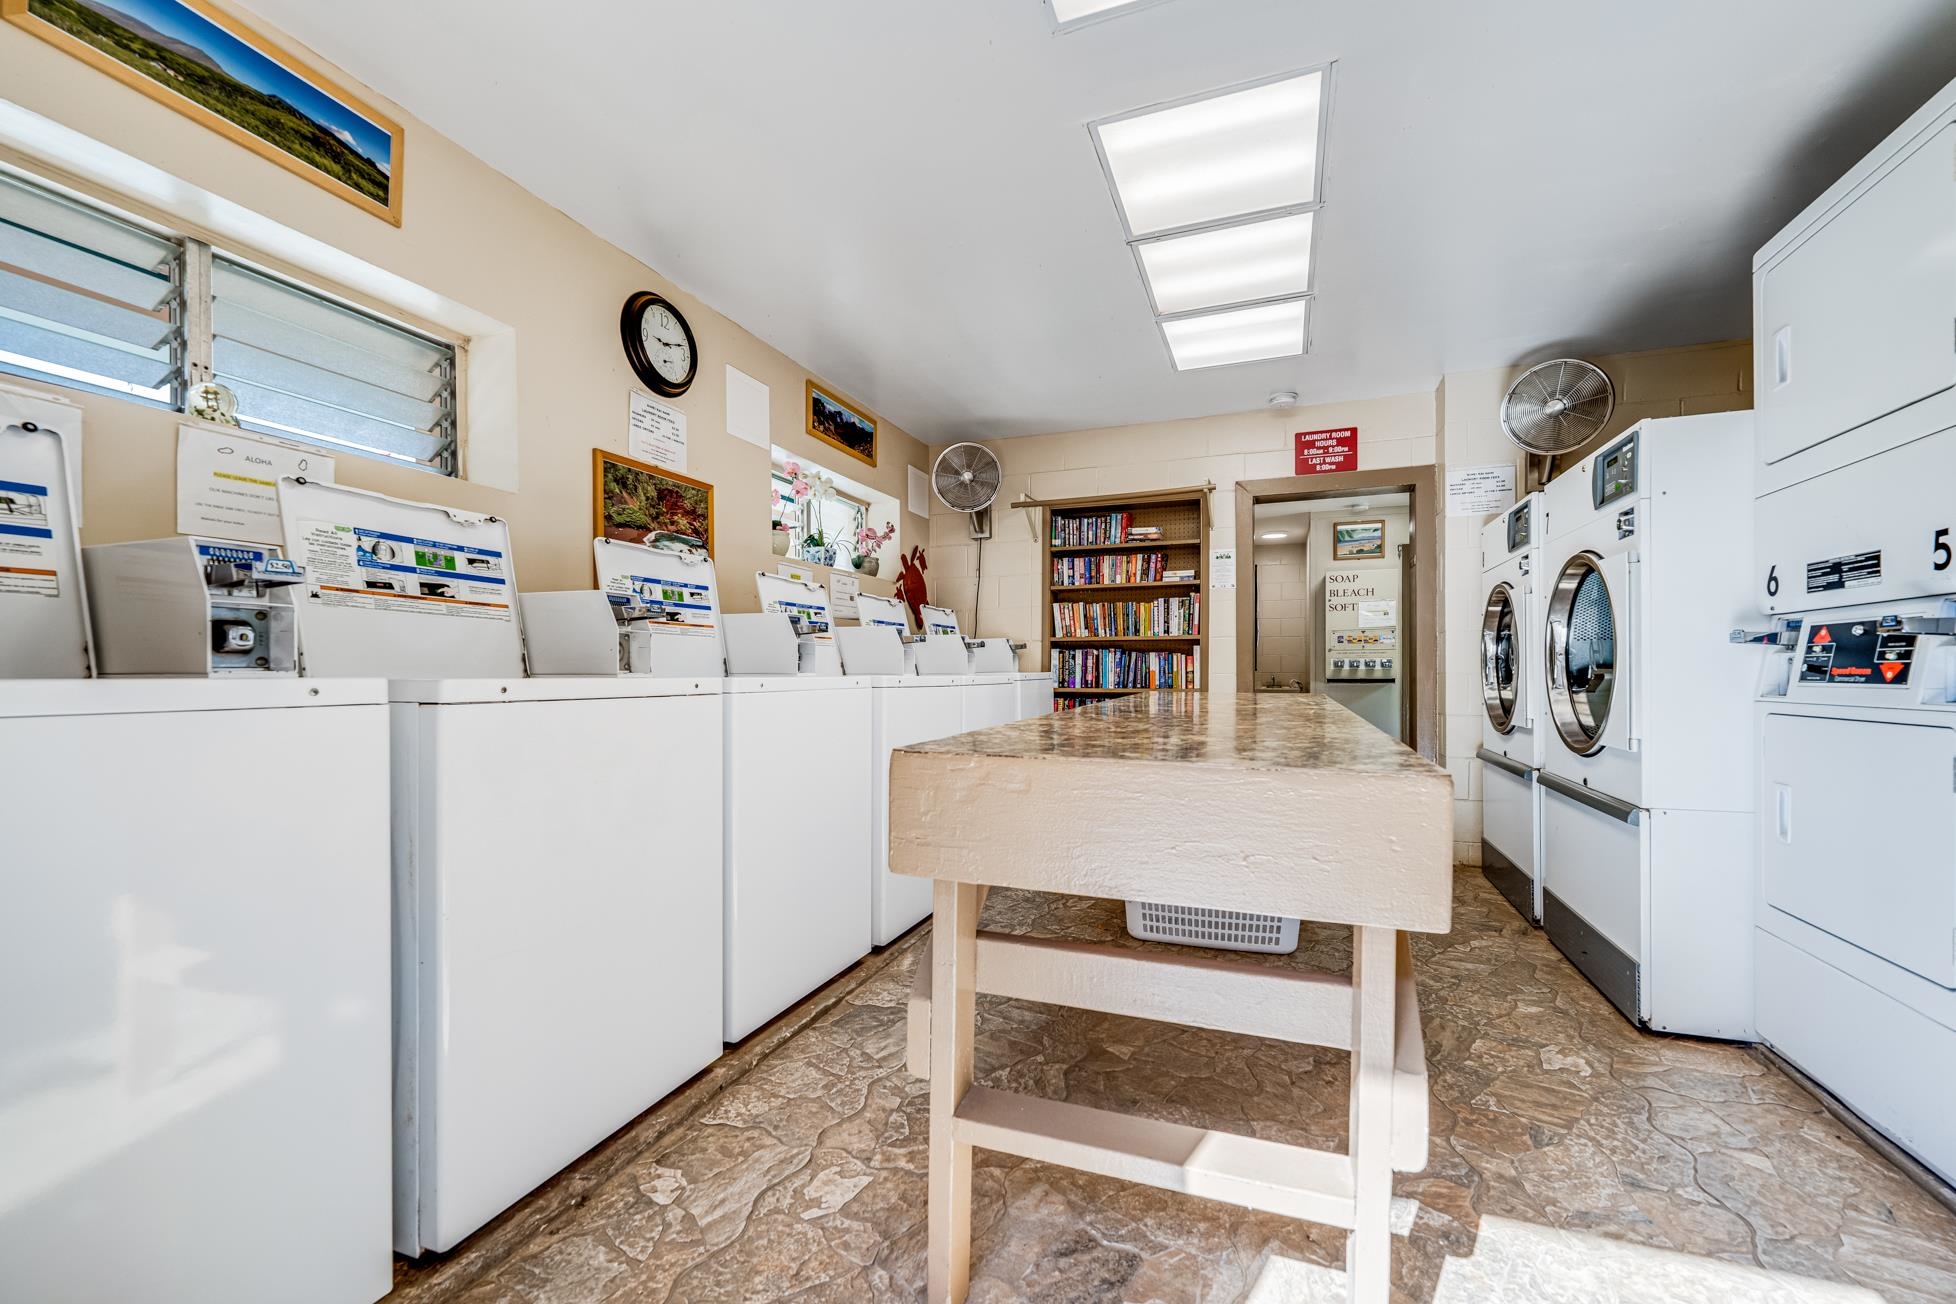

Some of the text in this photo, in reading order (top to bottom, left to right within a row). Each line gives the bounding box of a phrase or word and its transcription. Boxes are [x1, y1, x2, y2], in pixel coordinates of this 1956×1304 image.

[660, 312, 670, 330] 12
[642, 328, 648, 342] 9
[681, 348, 686, 362] 3
[1302, 432, 1330, 441] LAUNDRY
[245, 455, 273, 466] ALOHA
[1934, 528, 1952, 571] 5
[1329, 574, 1359, 583] SOAP
[1767, 564, 1779, 597] 6
[1329, 588, 1375, 598] BLEACH
[1328, 603, 1358, 612] SOFT
